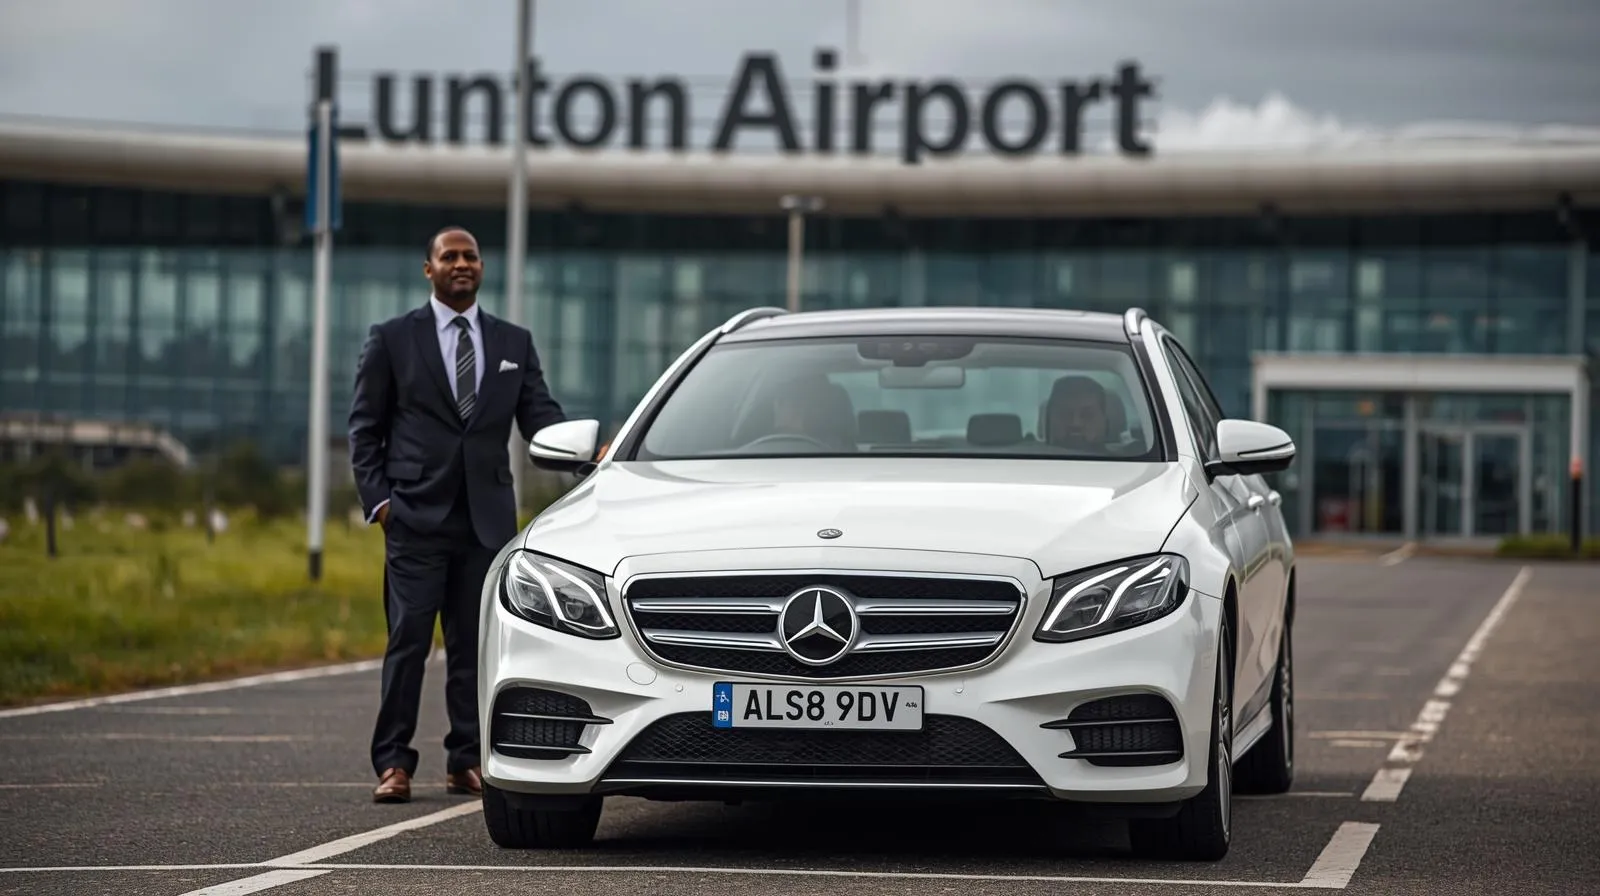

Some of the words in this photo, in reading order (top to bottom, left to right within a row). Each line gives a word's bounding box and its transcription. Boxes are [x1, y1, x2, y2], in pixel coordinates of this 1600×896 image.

[315, 46, 688, 152] Lunton
[709, 47, 1155, 163] Airport
[743, 690, 825, 721] ALS8
[836, 691, 899, 721] 9DV
